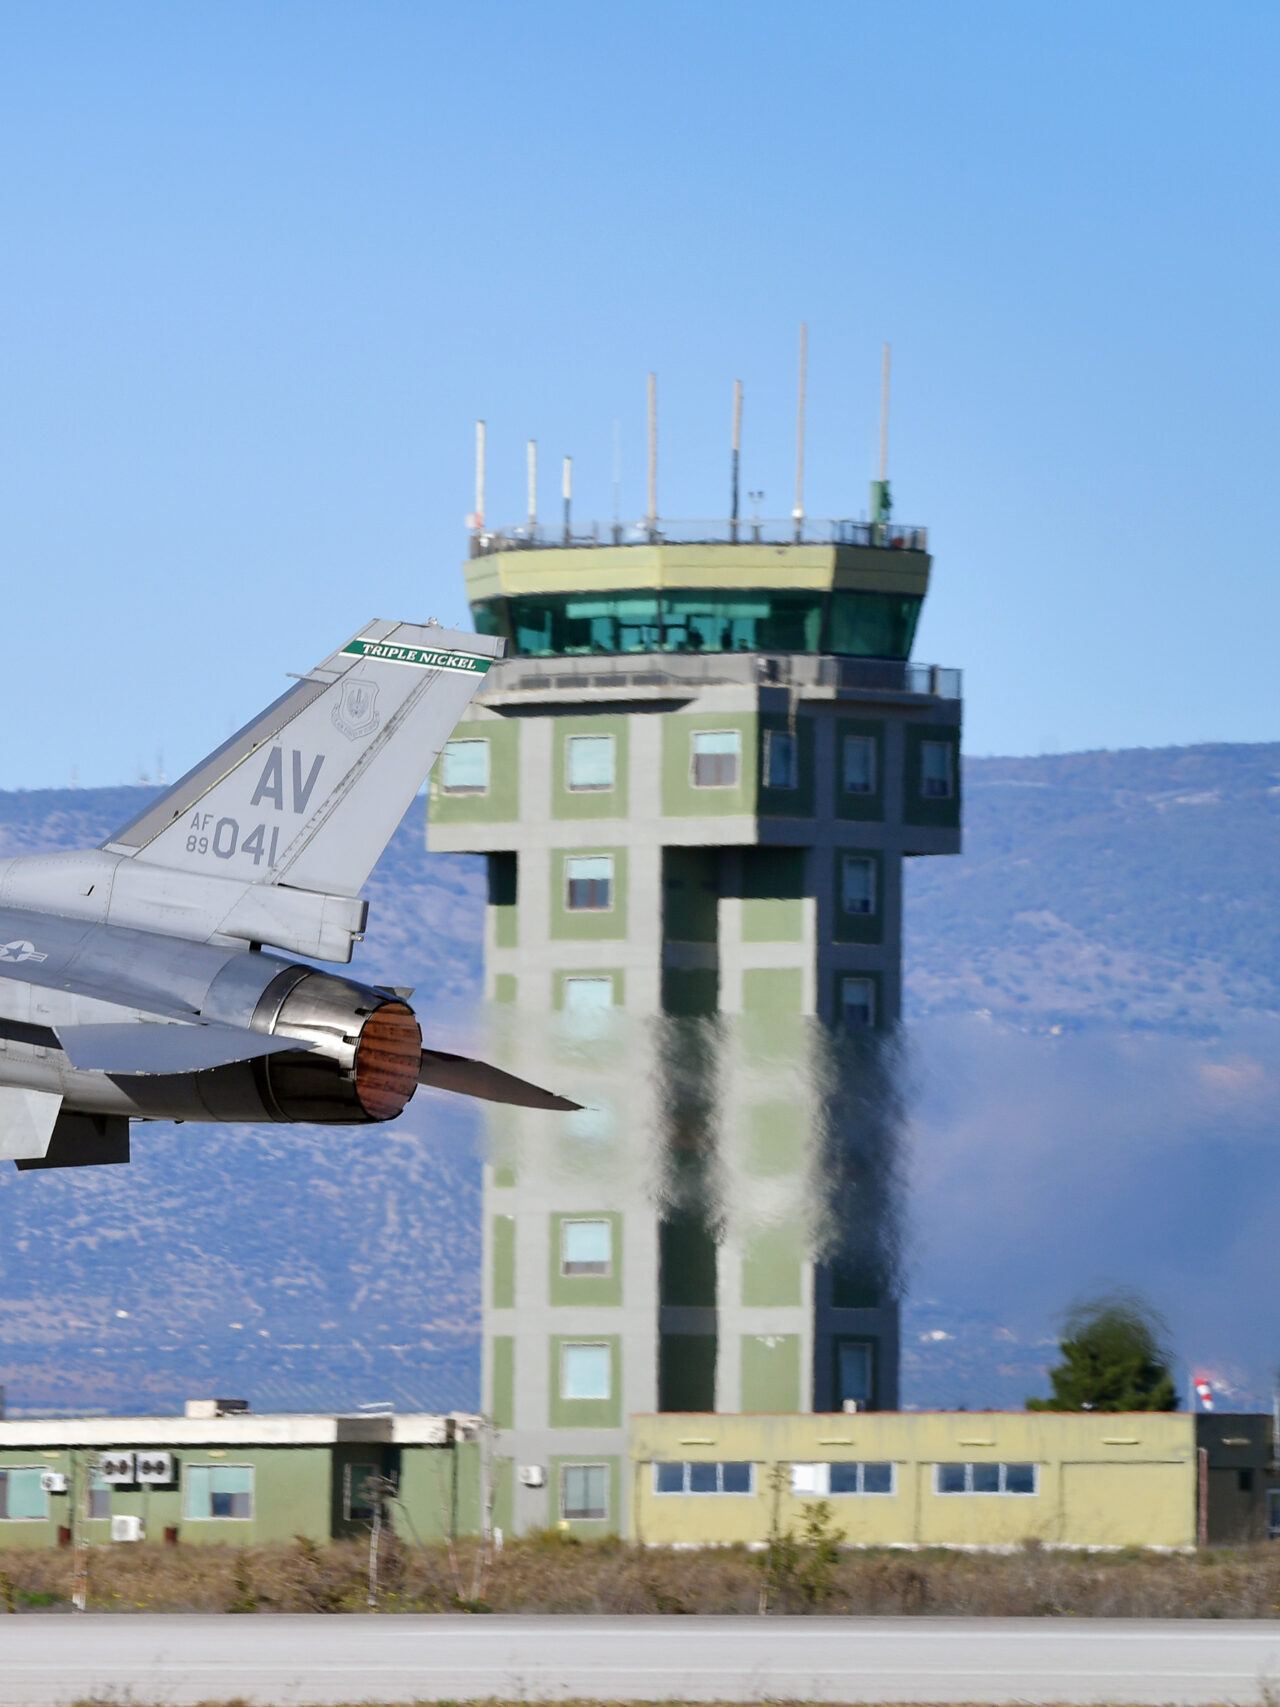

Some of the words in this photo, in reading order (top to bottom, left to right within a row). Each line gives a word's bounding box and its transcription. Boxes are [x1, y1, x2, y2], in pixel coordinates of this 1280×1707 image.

[363, 644, 417, 661] TRIPLE
[419, 653, 477, 670] NICKEL
[250, 746, 325, 814] AV
[191, 812, 214, 831] AF
[186, 835, 209, 855] 89
[212, 817, 280, 868] 041
